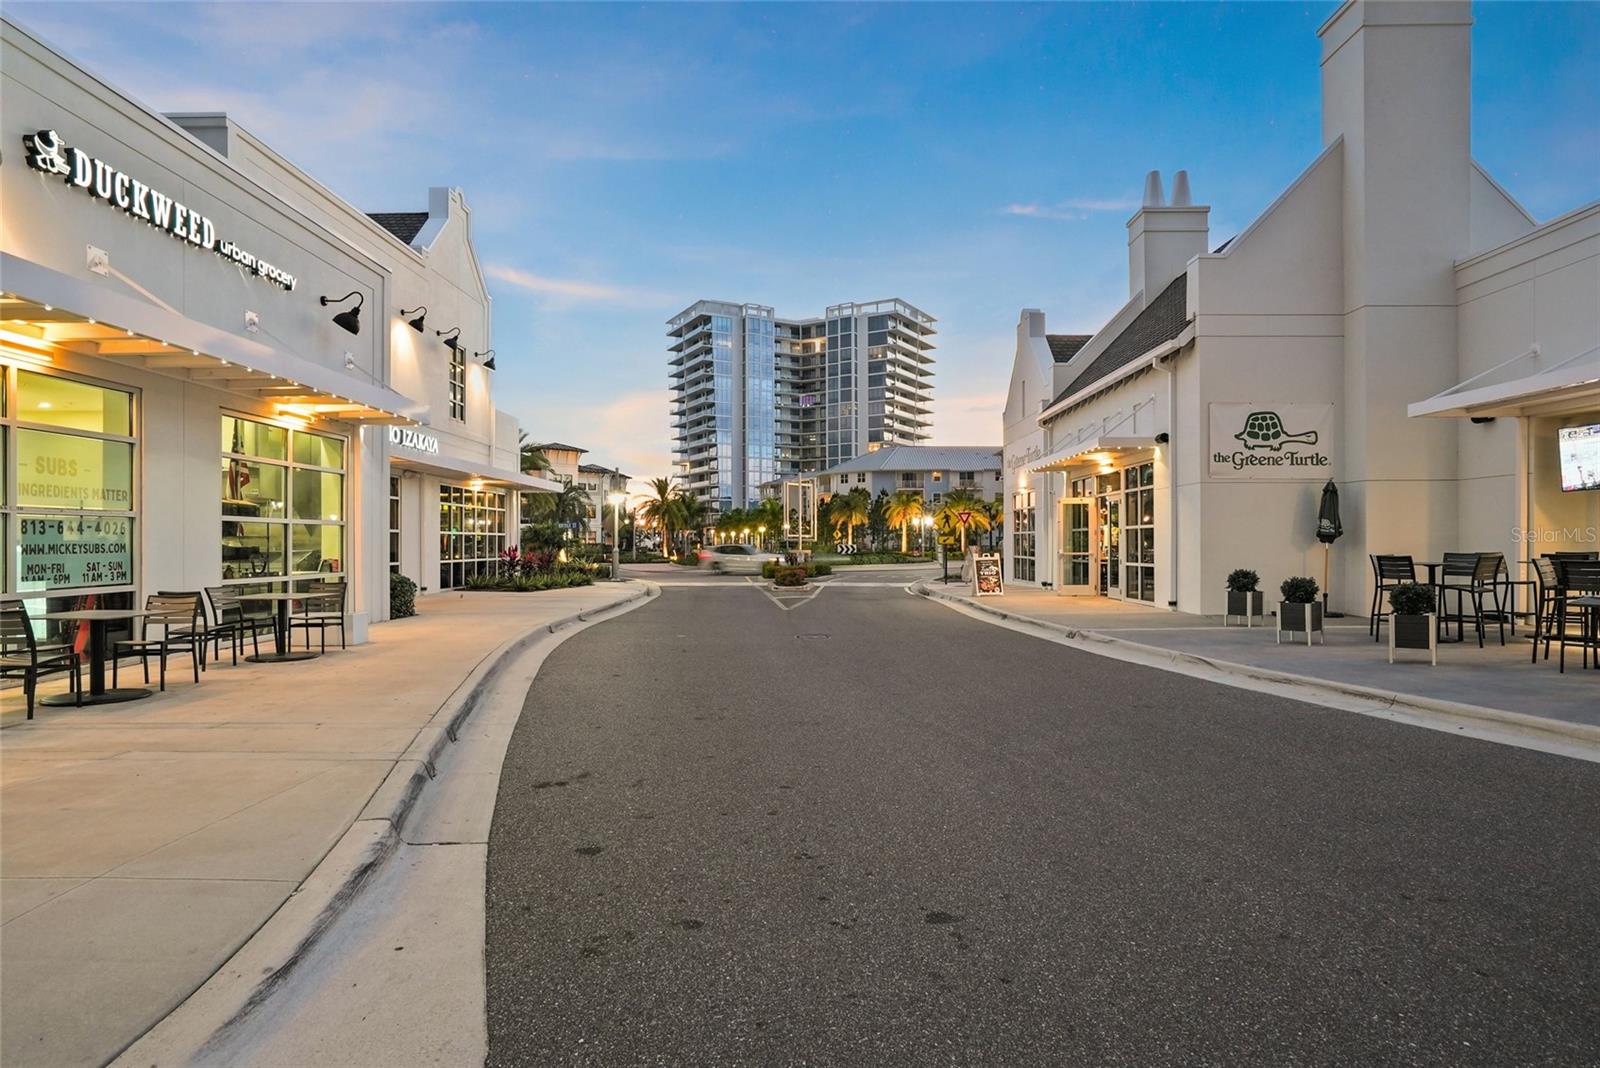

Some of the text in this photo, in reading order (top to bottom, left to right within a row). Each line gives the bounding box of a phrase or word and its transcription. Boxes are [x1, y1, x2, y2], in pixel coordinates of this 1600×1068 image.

[71, 147, 297, 291] DUCKWEED urban grocery
[402, 429, 439, 454] IZAKAYA
[35, 456, 78, 477] SUBS
[1213, 451, 1328, 470] the Greene Turtle
[19, 483, 128, 502] INGREDIENTS MATTER
[21, 519, 126, 536] 813-644-4026
[21, 543, 127, 555] WWW.MICKEYSUBS.COM
[26, 563, 65, 575] MON-FRI
[86, 562, 100, 573] SAT
[108, 561, 123, 571] SUN
